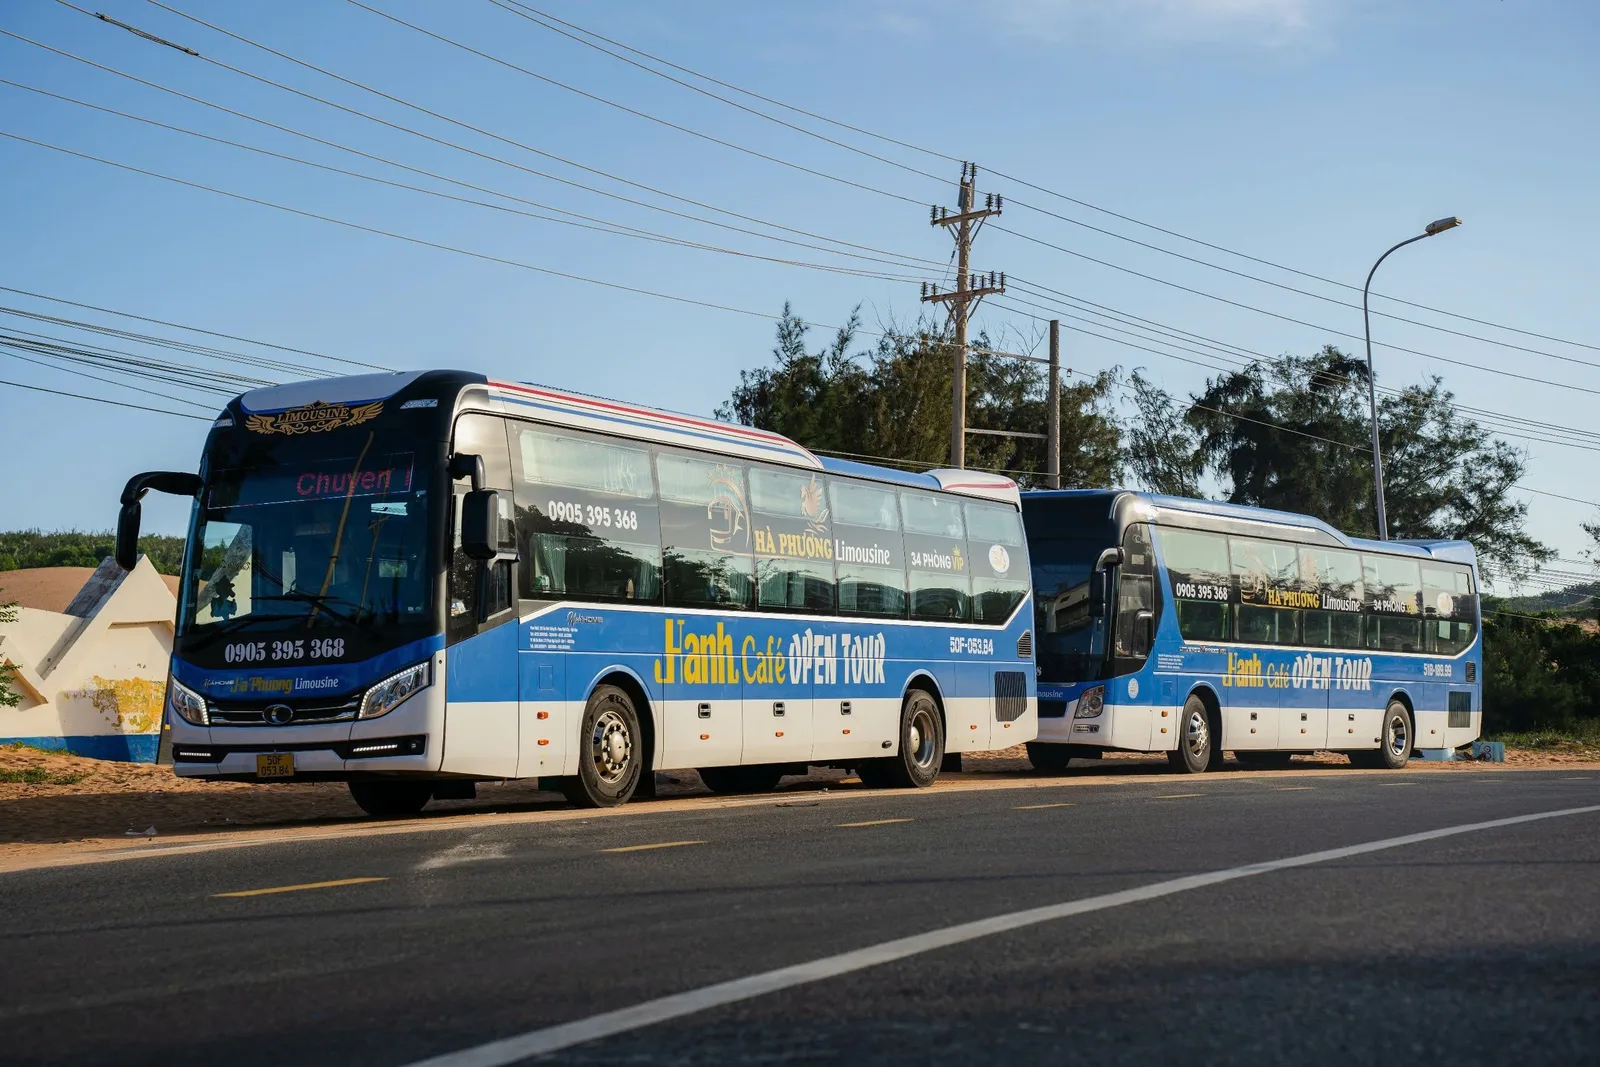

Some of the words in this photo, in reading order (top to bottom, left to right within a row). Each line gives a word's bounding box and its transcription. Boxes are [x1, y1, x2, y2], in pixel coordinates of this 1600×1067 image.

[277, 407, 350, 424] LIMOUSINE
[548, 500, 583, 524] 0905
[586, 504, 612, 528] 395
[614, 508, 638, 531] 368
[754, 525, 777, 553] HÀ
[834, 539, 891, 566] Limousine
[910, 551, 922, 566] 34
[922, 548, 952, 569] PHÒNG
[951, 556, 964, 571] VIP
[1176, 582, 1196, 598] 0905
[1197, 584, 1213, 599] 395
[1213, 585, 1228, 600] 368
[1322, 594, 1361, 612] Limousine
[224, 641, 266, 663] 0905
[271, 640, 304, 661] 395
[310, 638, 345, 659] 368
[654, 618, 740, 684] Hanh
[741, 634, 786, 684] Café
[788, 628, 837, 685] OPEN
[841, 631, 886, 684] TOUR
[949, 636, 994, 656] 50F-053.84
[1222, 652, 1264, 688] Hanh
[1265, 663, 1290, 689] Café
[1292, 653, 1333, 690] OPEN
[1335, 656, 1373, 691] TOUR
[294, 676, 339, 690] Limousine
[1037, 689, 1064, 698] mousine
[267, 755, 283, 765] 50F
[261, 765, 290, 776] 053.84
